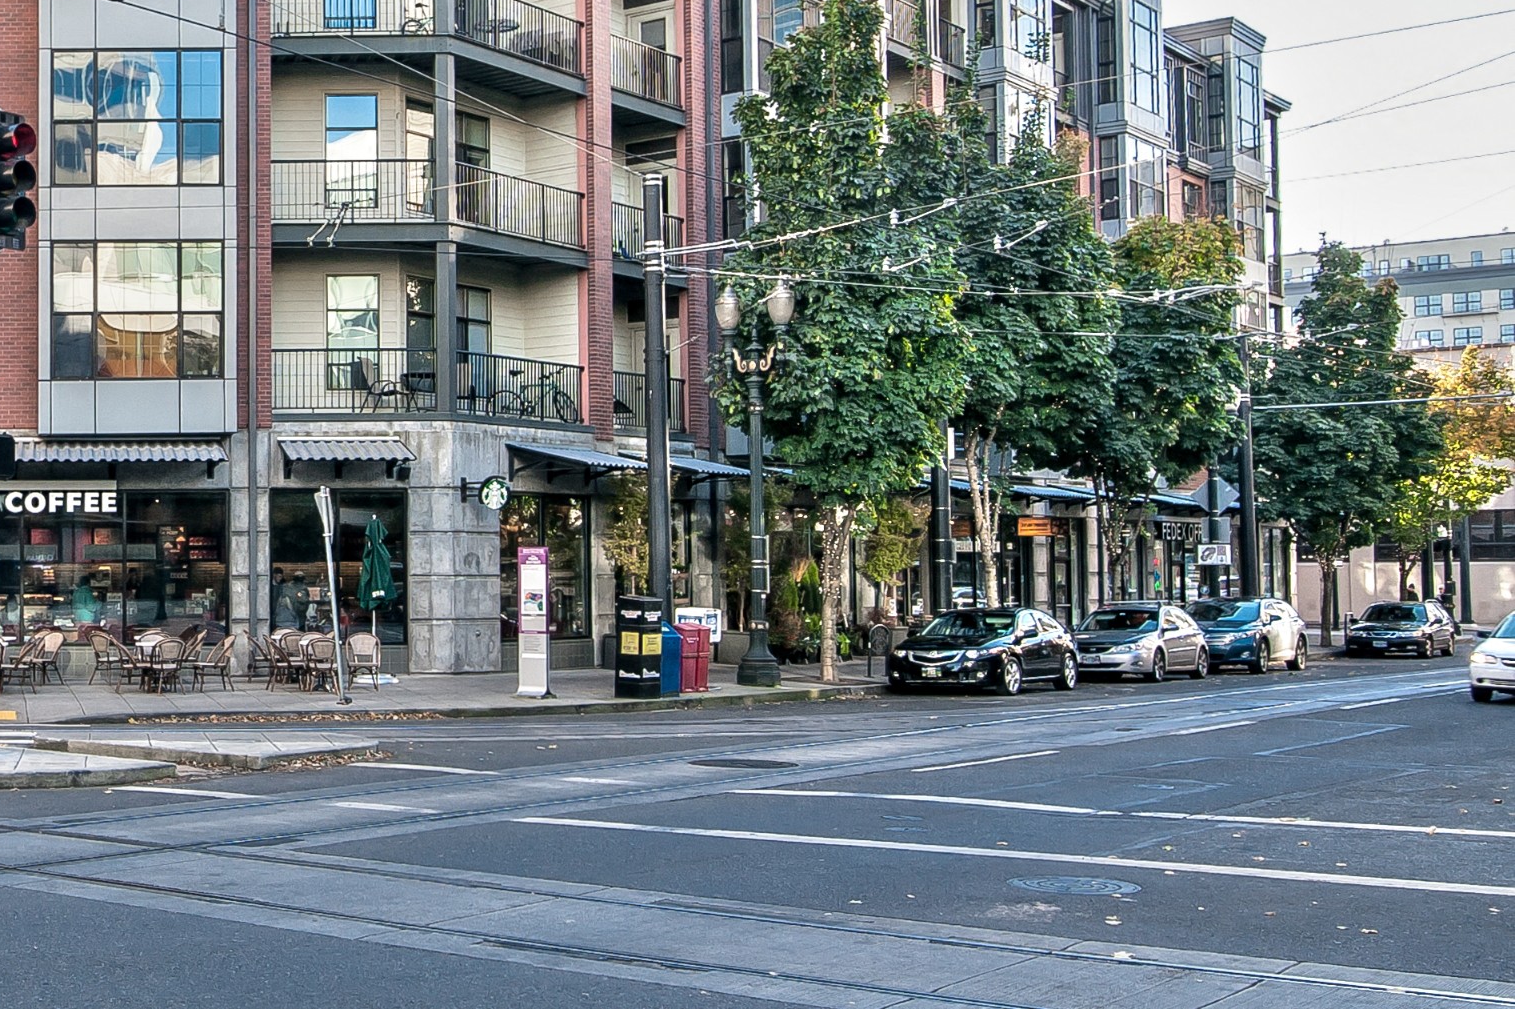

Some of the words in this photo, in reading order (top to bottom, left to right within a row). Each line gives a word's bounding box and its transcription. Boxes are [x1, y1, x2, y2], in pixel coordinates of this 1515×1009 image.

[5, 491, 117, 513] COFFEE
[1162, 522, 1187, 540] FEDEX
[1188, 523, 1202, 542] OFF
